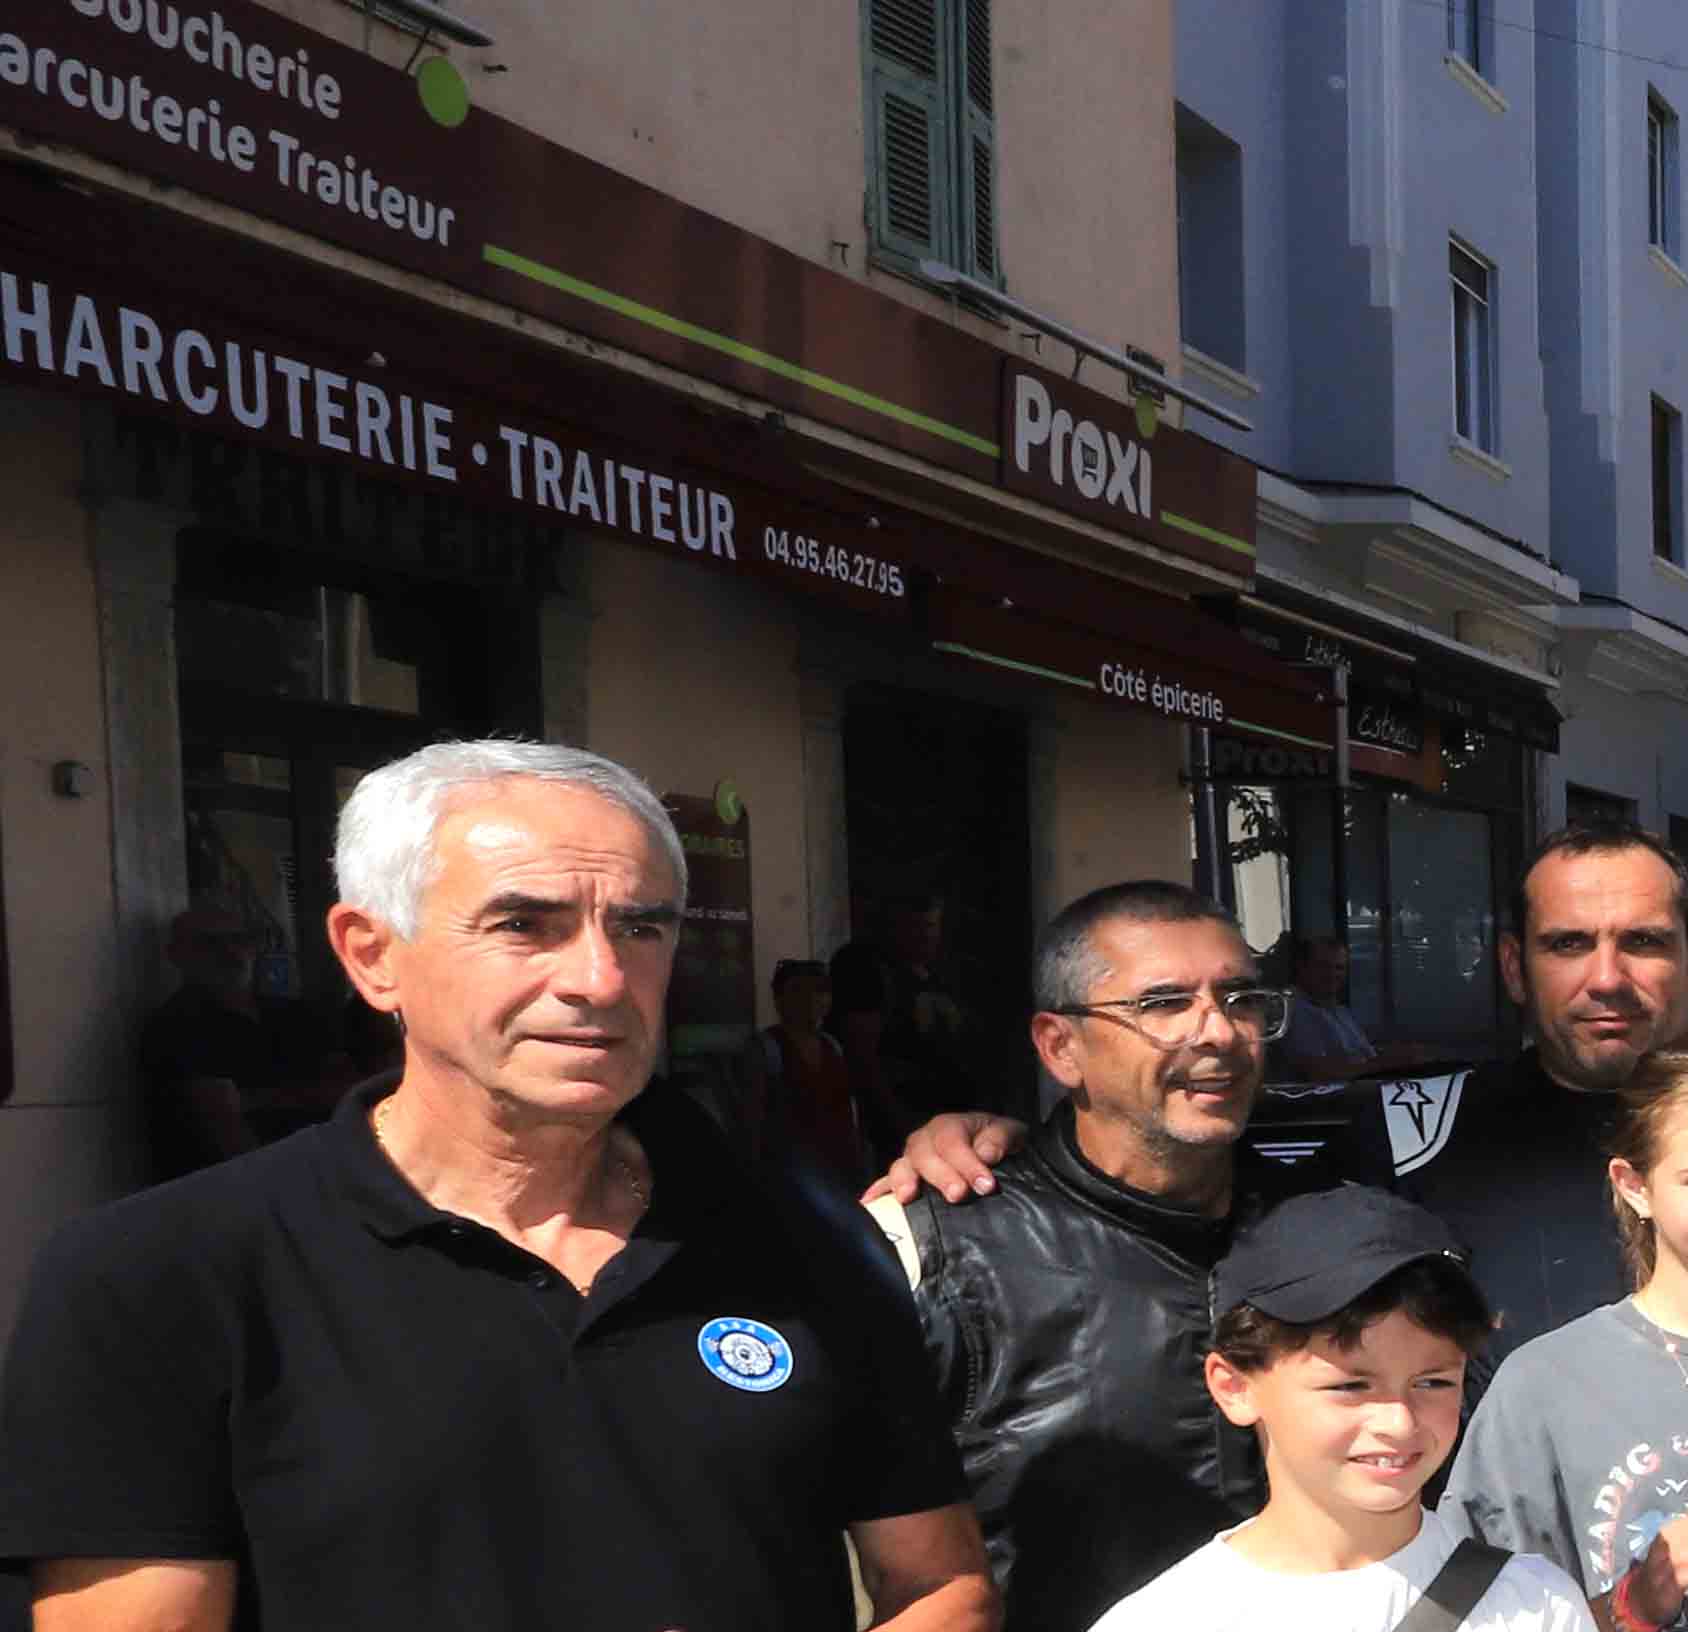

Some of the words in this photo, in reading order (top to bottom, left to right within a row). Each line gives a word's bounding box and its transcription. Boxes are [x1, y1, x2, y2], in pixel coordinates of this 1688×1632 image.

[70, 0, 342, 119] oucherie
[268, 129, 456, 247] Traiteur
[500, 425, 738, 560] TRAITEUR
[764, 526, 905, 597] 04.95.46.27.95
[1100, 663, 1147, 702] Côté
[1151, 675, 1224, 722] épicerie
